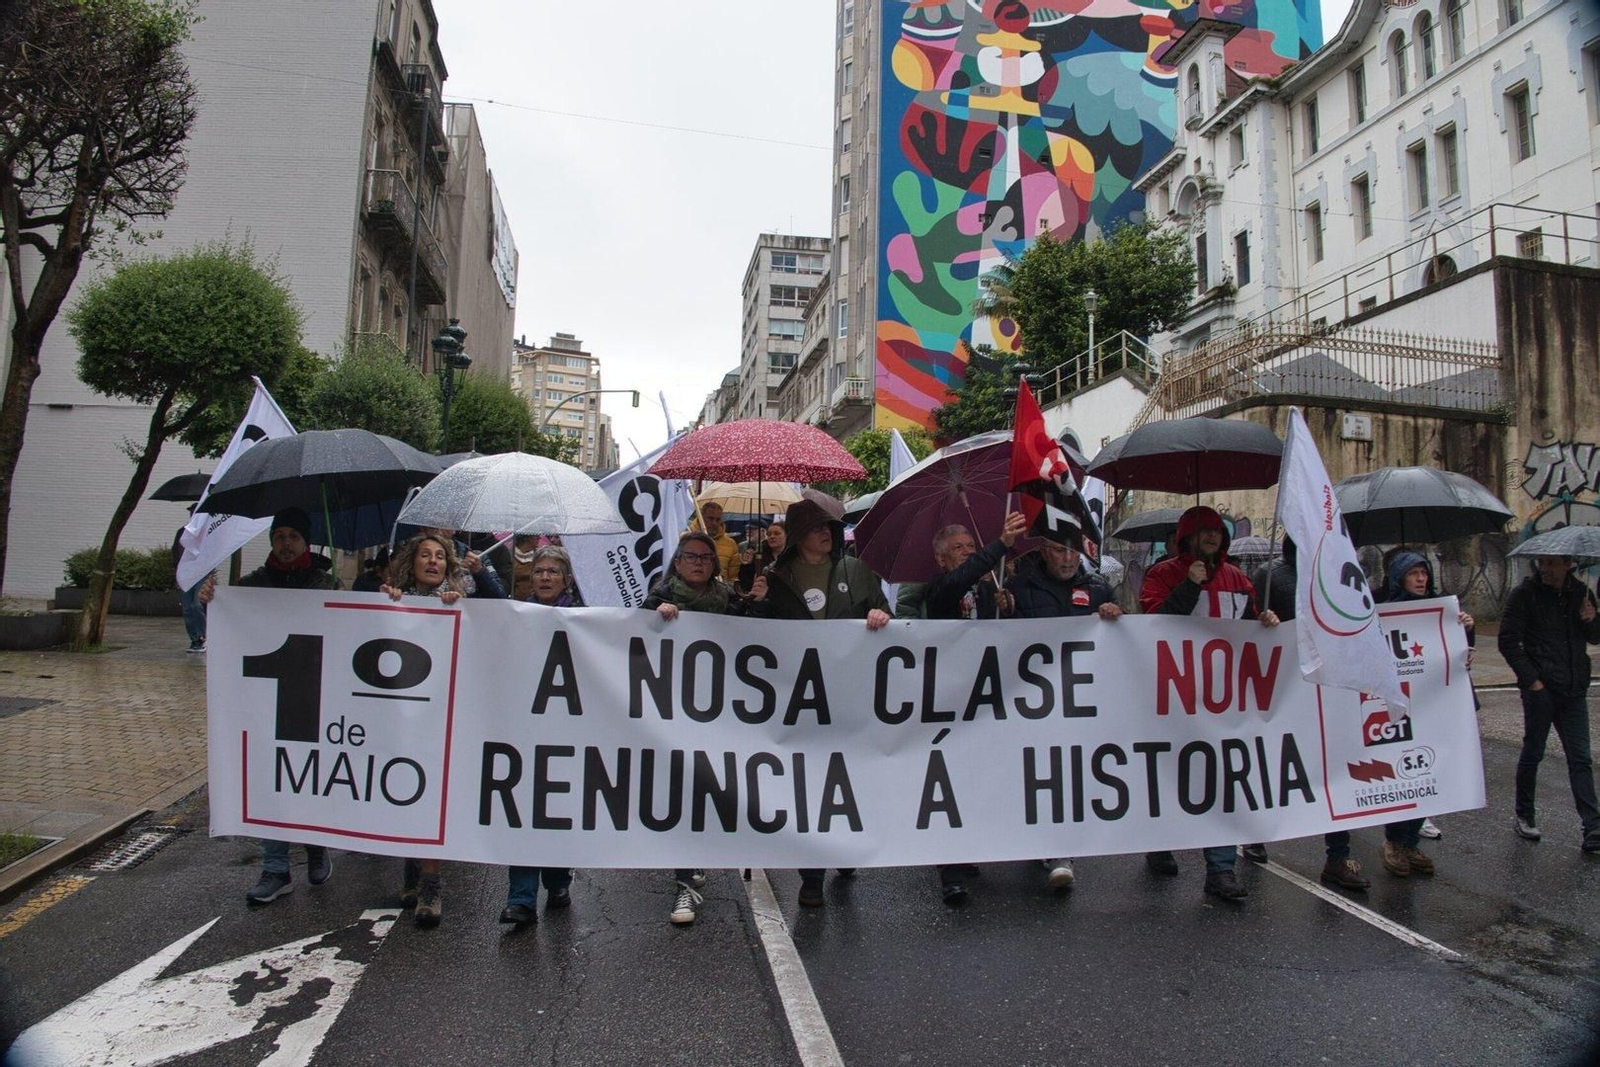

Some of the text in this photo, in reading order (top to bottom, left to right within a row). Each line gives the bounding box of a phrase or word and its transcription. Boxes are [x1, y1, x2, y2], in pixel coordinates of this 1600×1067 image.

[606, 550, 616, 565] de
[617, 545, 639, 591] Central
[531, 630, 1282, 726] A NOSA CLASE NON
[326, 715, 366, 746] de
[1368, 719, 1407, 741] CGT
[275, 746, 427, 806] MAIO
[1403, 754, 1429, 771] S.F.
[478, 728, 1316, 834] RENUNCIA Á HISTORIA
[1355, 785, 1438, 808] INTERSINDICAL
